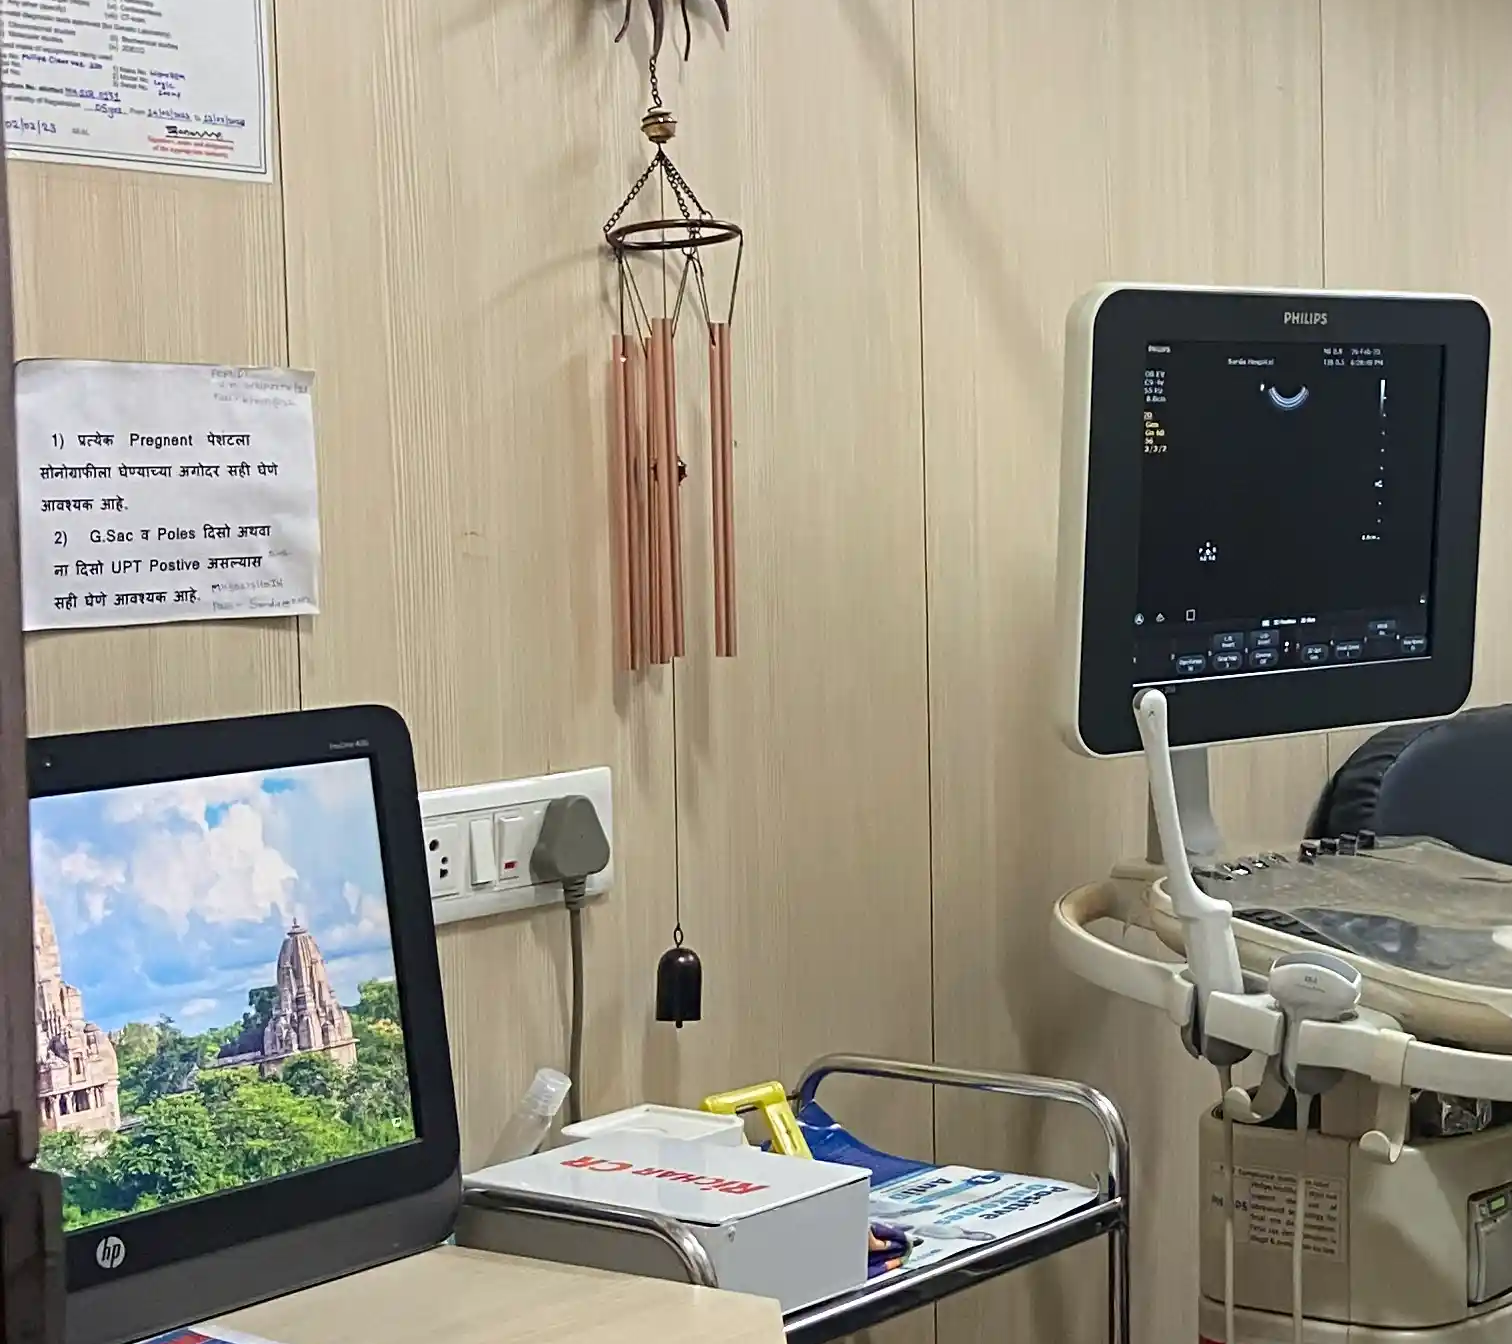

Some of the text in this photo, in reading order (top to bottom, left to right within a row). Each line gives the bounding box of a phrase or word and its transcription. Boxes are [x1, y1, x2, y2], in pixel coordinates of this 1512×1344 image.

[1284, 311, 1328, 326] PHILIPS
[52, 432, 65, 449] 1)
[77, 431, 115, 447] प्रत्येक
[179, 462, 220, 478] अगोदर
[227, 461, 250, 477] सही
[257, 462, 278, 477] घेणे
[40, 497, 93, 512] आवश्यक
[54, 522, 271, 547] 2) G.Sac व Poles दिसो अथवा
[54, 555, 263, 577] ना दिसो UPT Postive असल्यास
[54, 592, 78, 610] सही
[114, 589, 167, 605] आवश्यक
[560, 1155, 633, 1172] CR
[933, 1183, 1049, 1225] Outcomes
[978, 1185, 1070, 1220] Positive
[98, 1236, 124, 1269] hp
